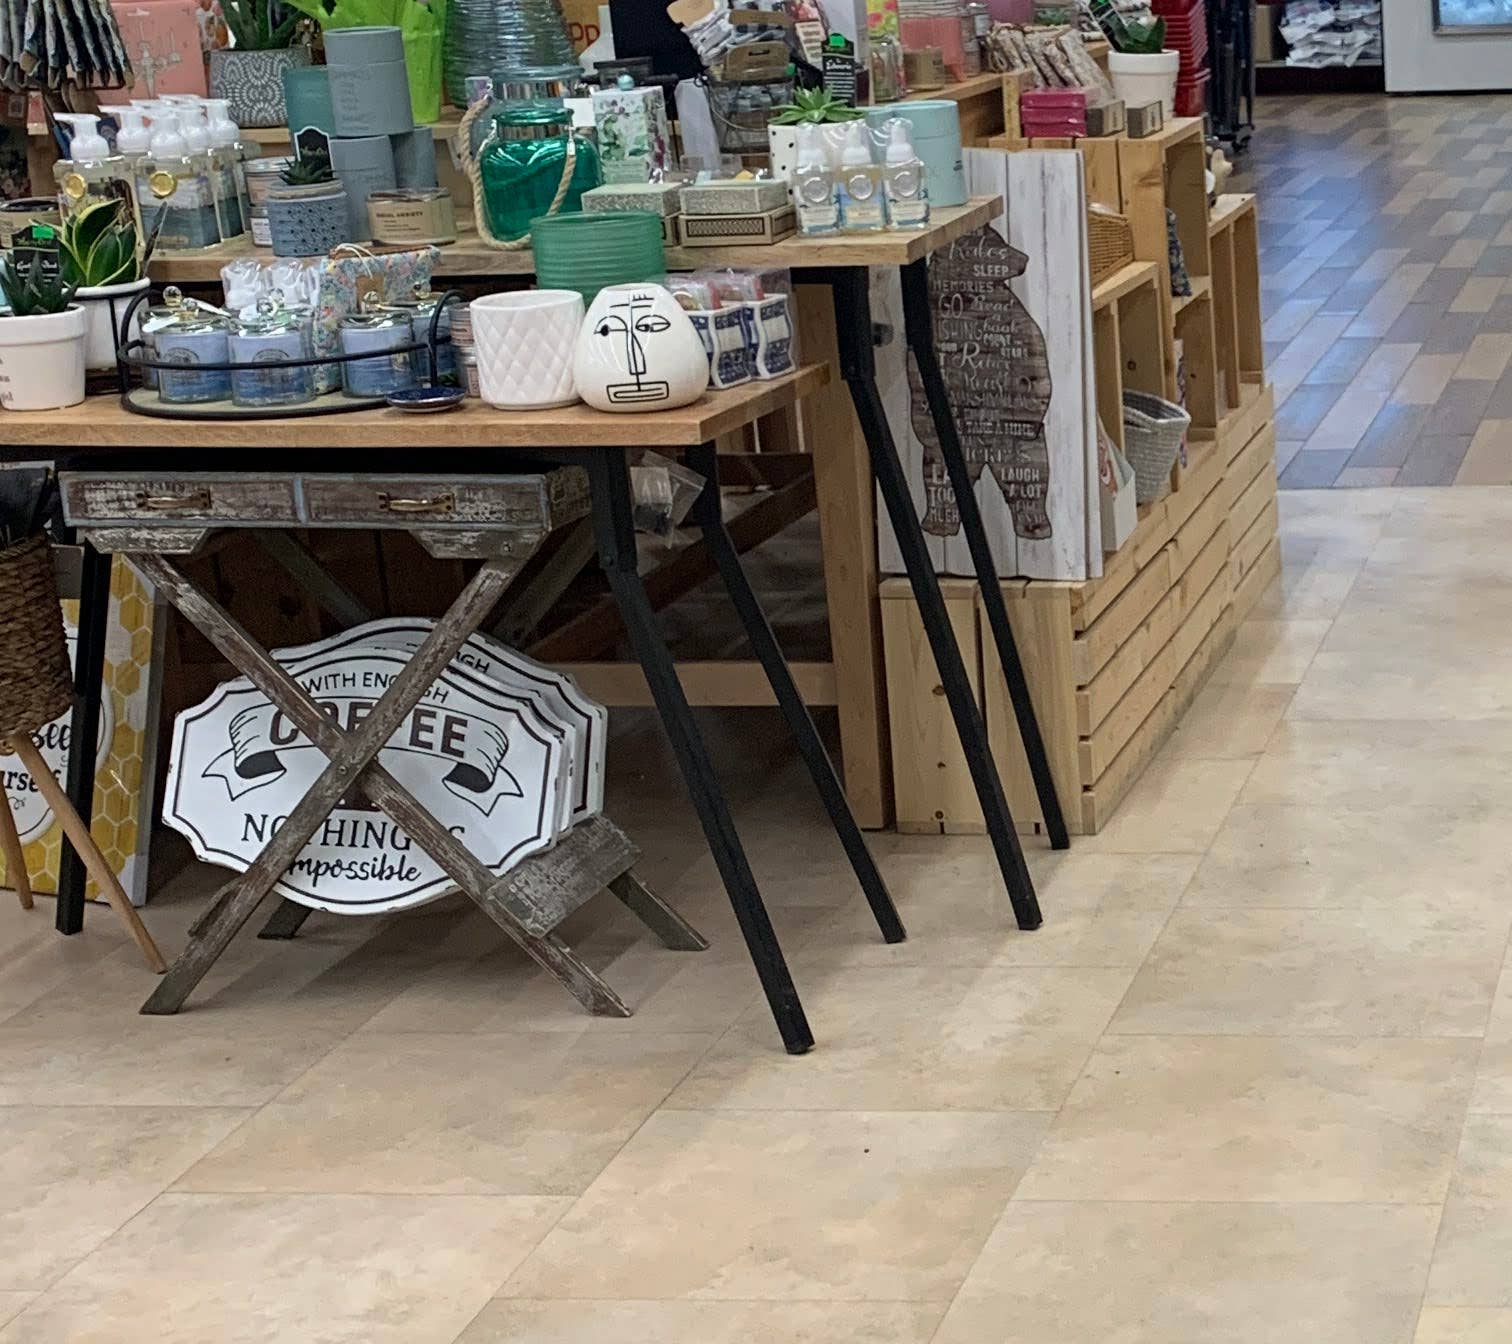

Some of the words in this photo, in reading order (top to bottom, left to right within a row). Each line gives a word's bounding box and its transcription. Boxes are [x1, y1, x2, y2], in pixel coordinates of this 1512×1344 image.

[973, 264, 1009, 277] SLEEP
[1001, 468, 1039, 482] LAUGH
[301, 672, 356, 694] WITH
[288, 853, 422, 888] mpossible
